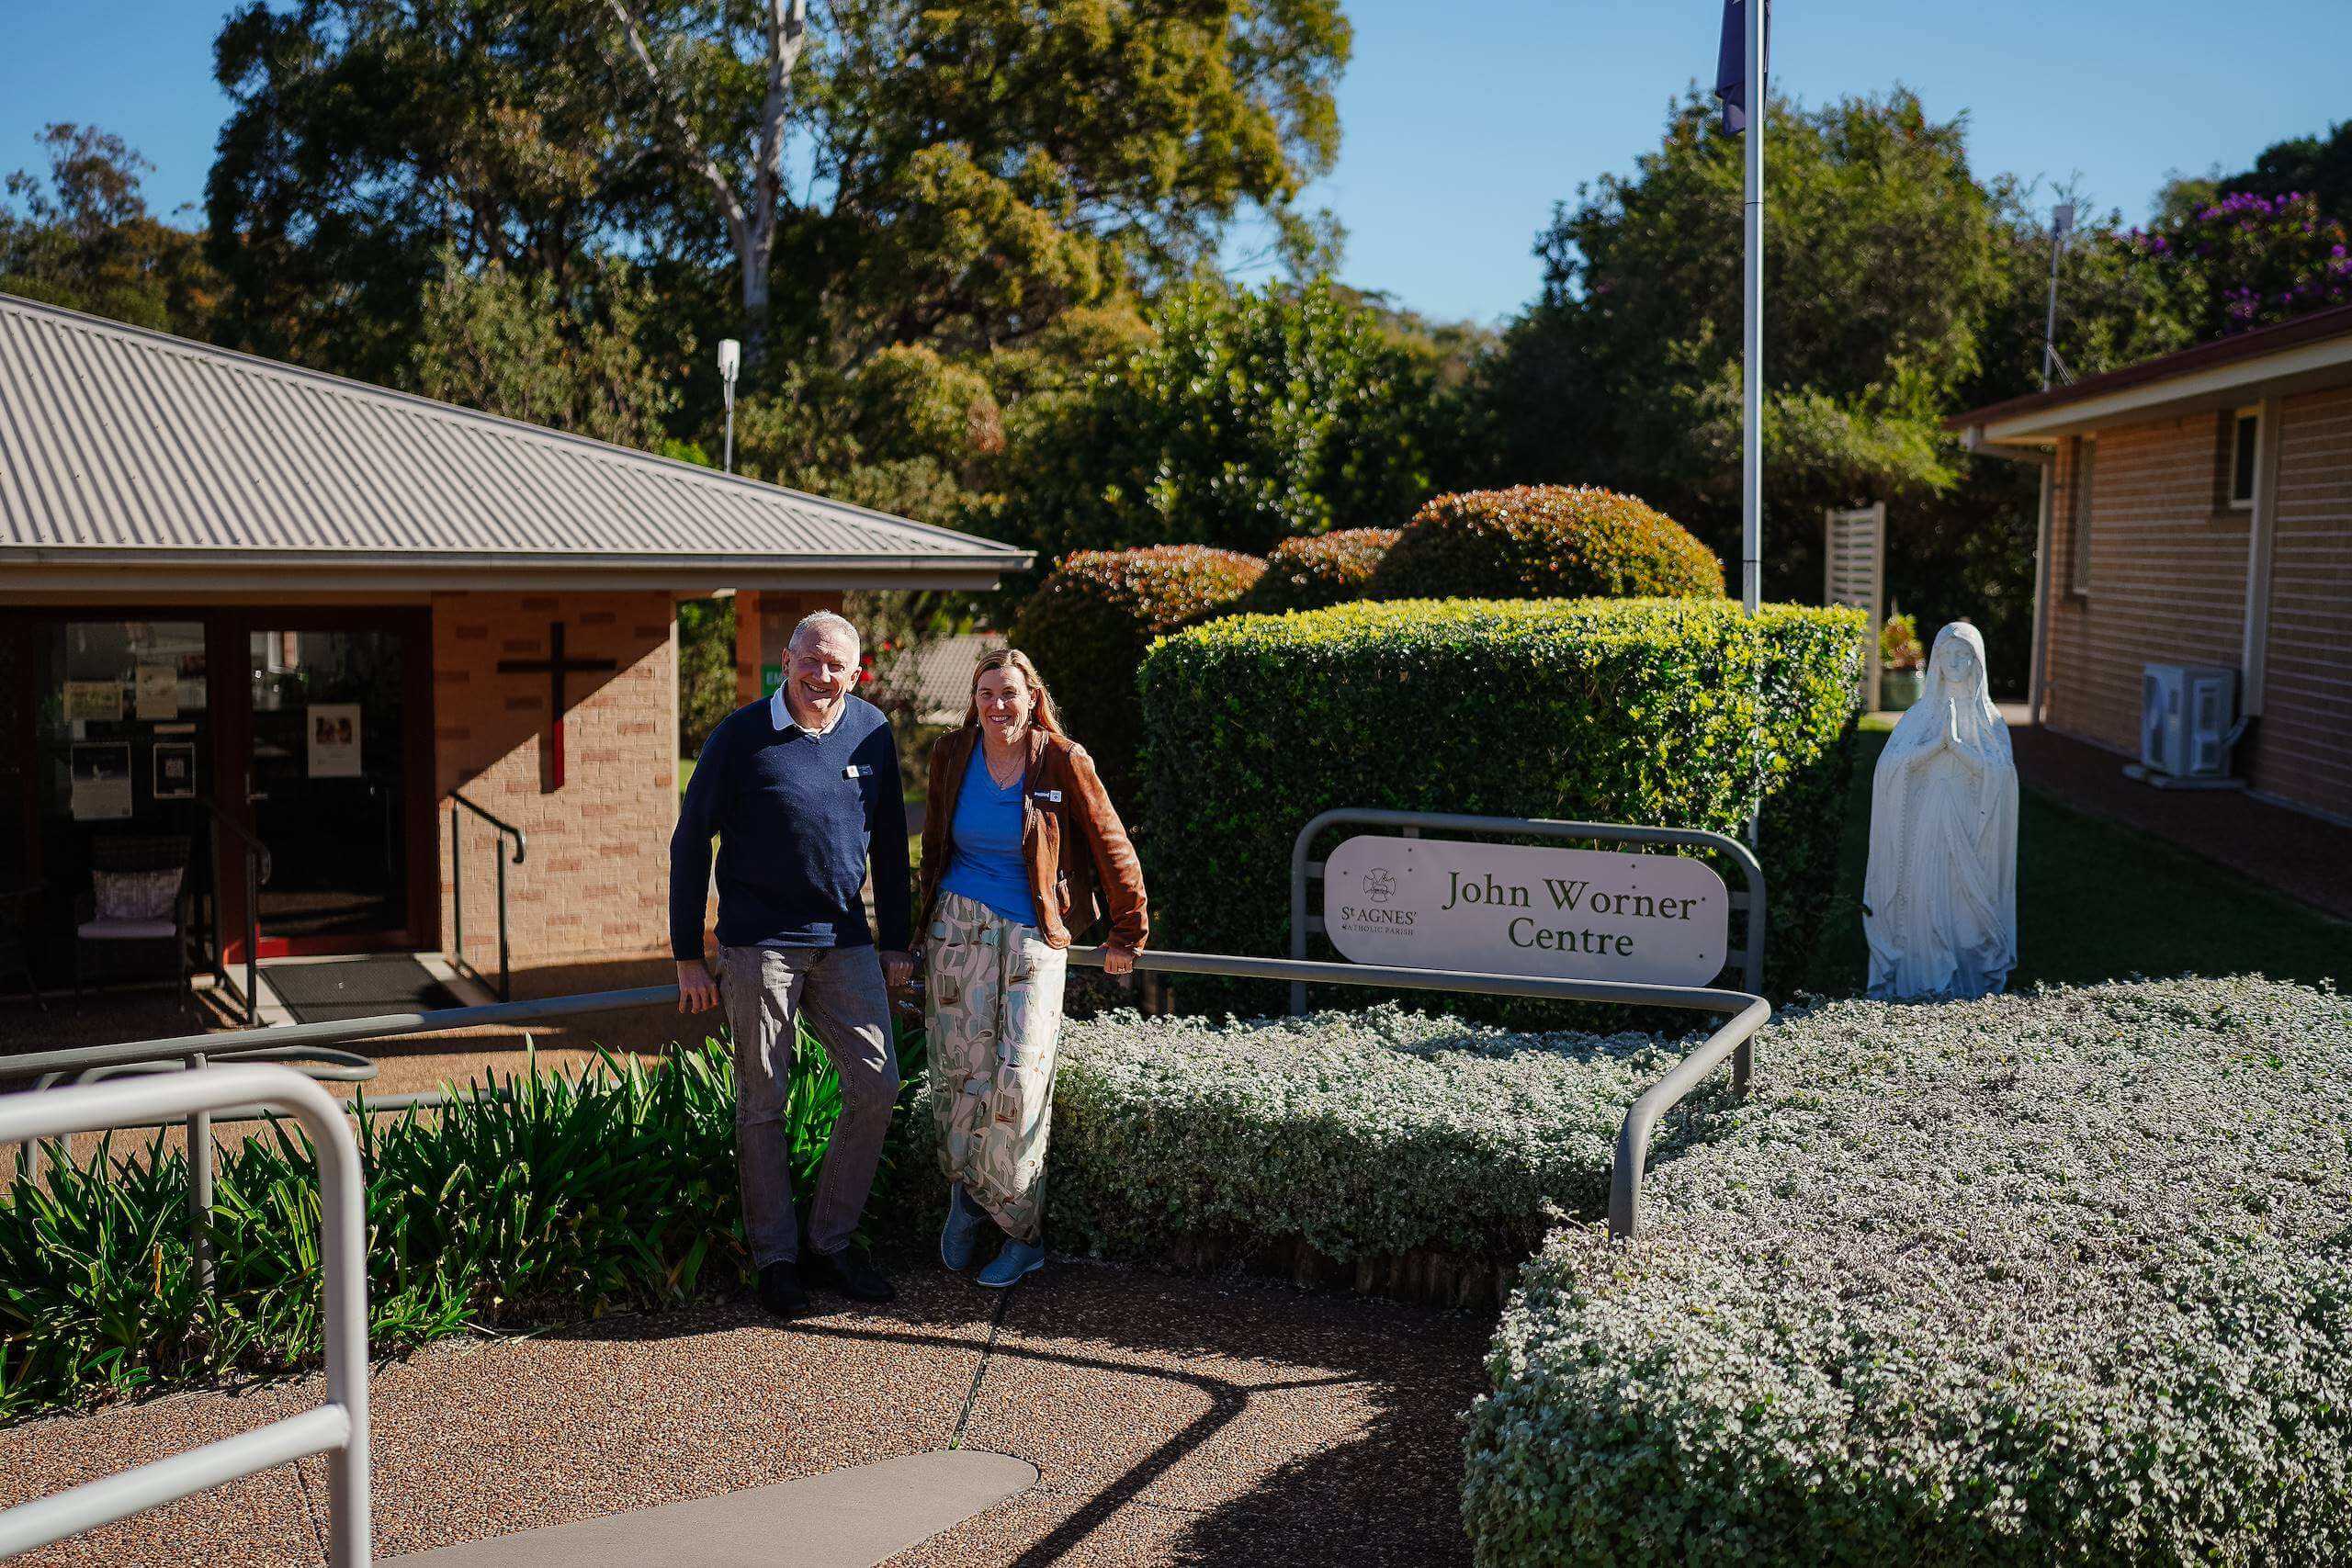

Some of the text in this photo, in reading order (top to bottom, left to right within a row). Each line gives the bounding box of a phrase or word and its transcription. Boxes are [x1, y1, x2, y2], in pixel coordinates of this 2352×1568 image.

[1341, 906, 1354, 920] St
[1442, 872, 1697, 920] John Worner
[1508, 917, 1634, 957] Centre
